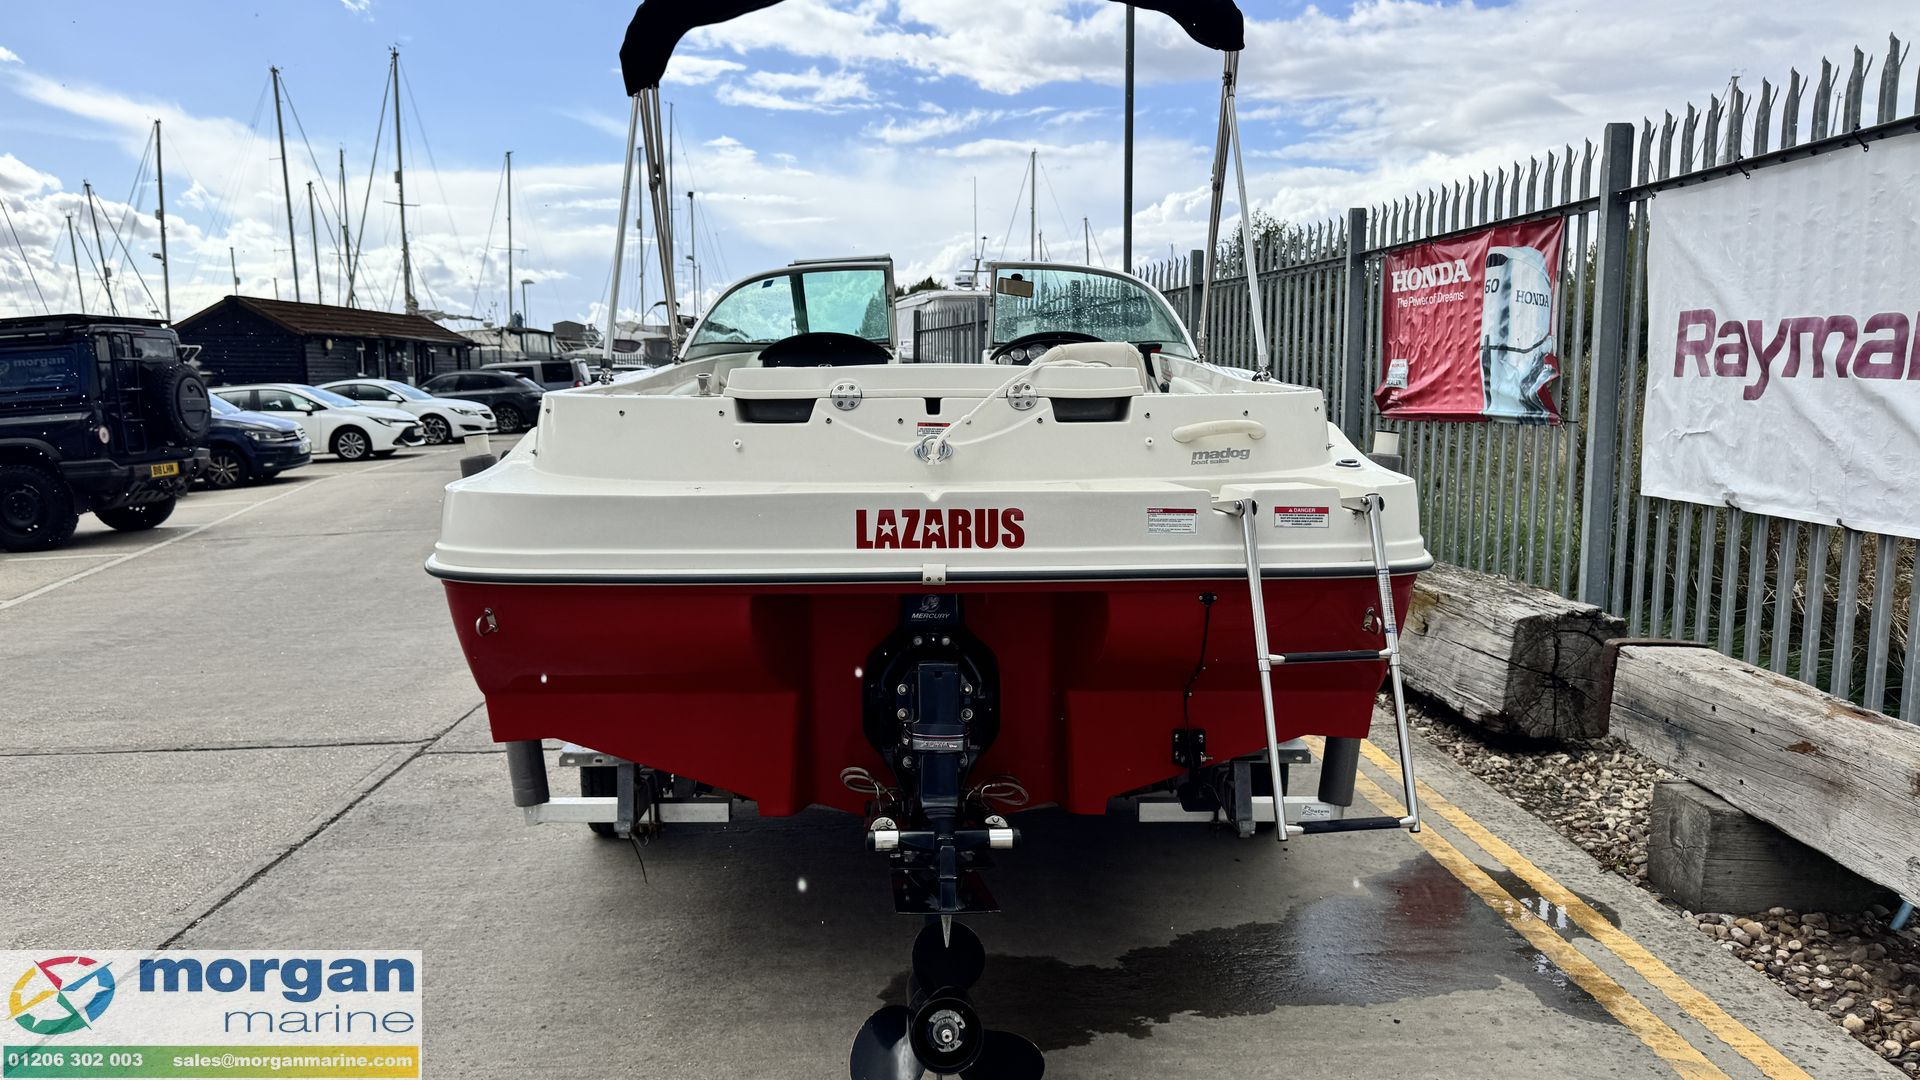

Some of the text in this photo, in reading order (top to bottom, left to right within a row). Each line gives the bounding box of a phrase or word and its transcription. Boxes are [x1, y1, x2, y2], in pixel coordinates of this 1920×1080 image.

[1391, 259, 1471, 293] HONDA
[1485, 279, 1499, 293] 60
[1397, 292, 1464, 308] The Power of Dreams
[1516, 290, 1549, 307] HONDA
[14, 357, 65, 367] morgan
[1673, 309, 1920, 400] Rayma
[1192, 448, 1250, 460] madog
[856, 508, 1025, 549] LAZARUS
